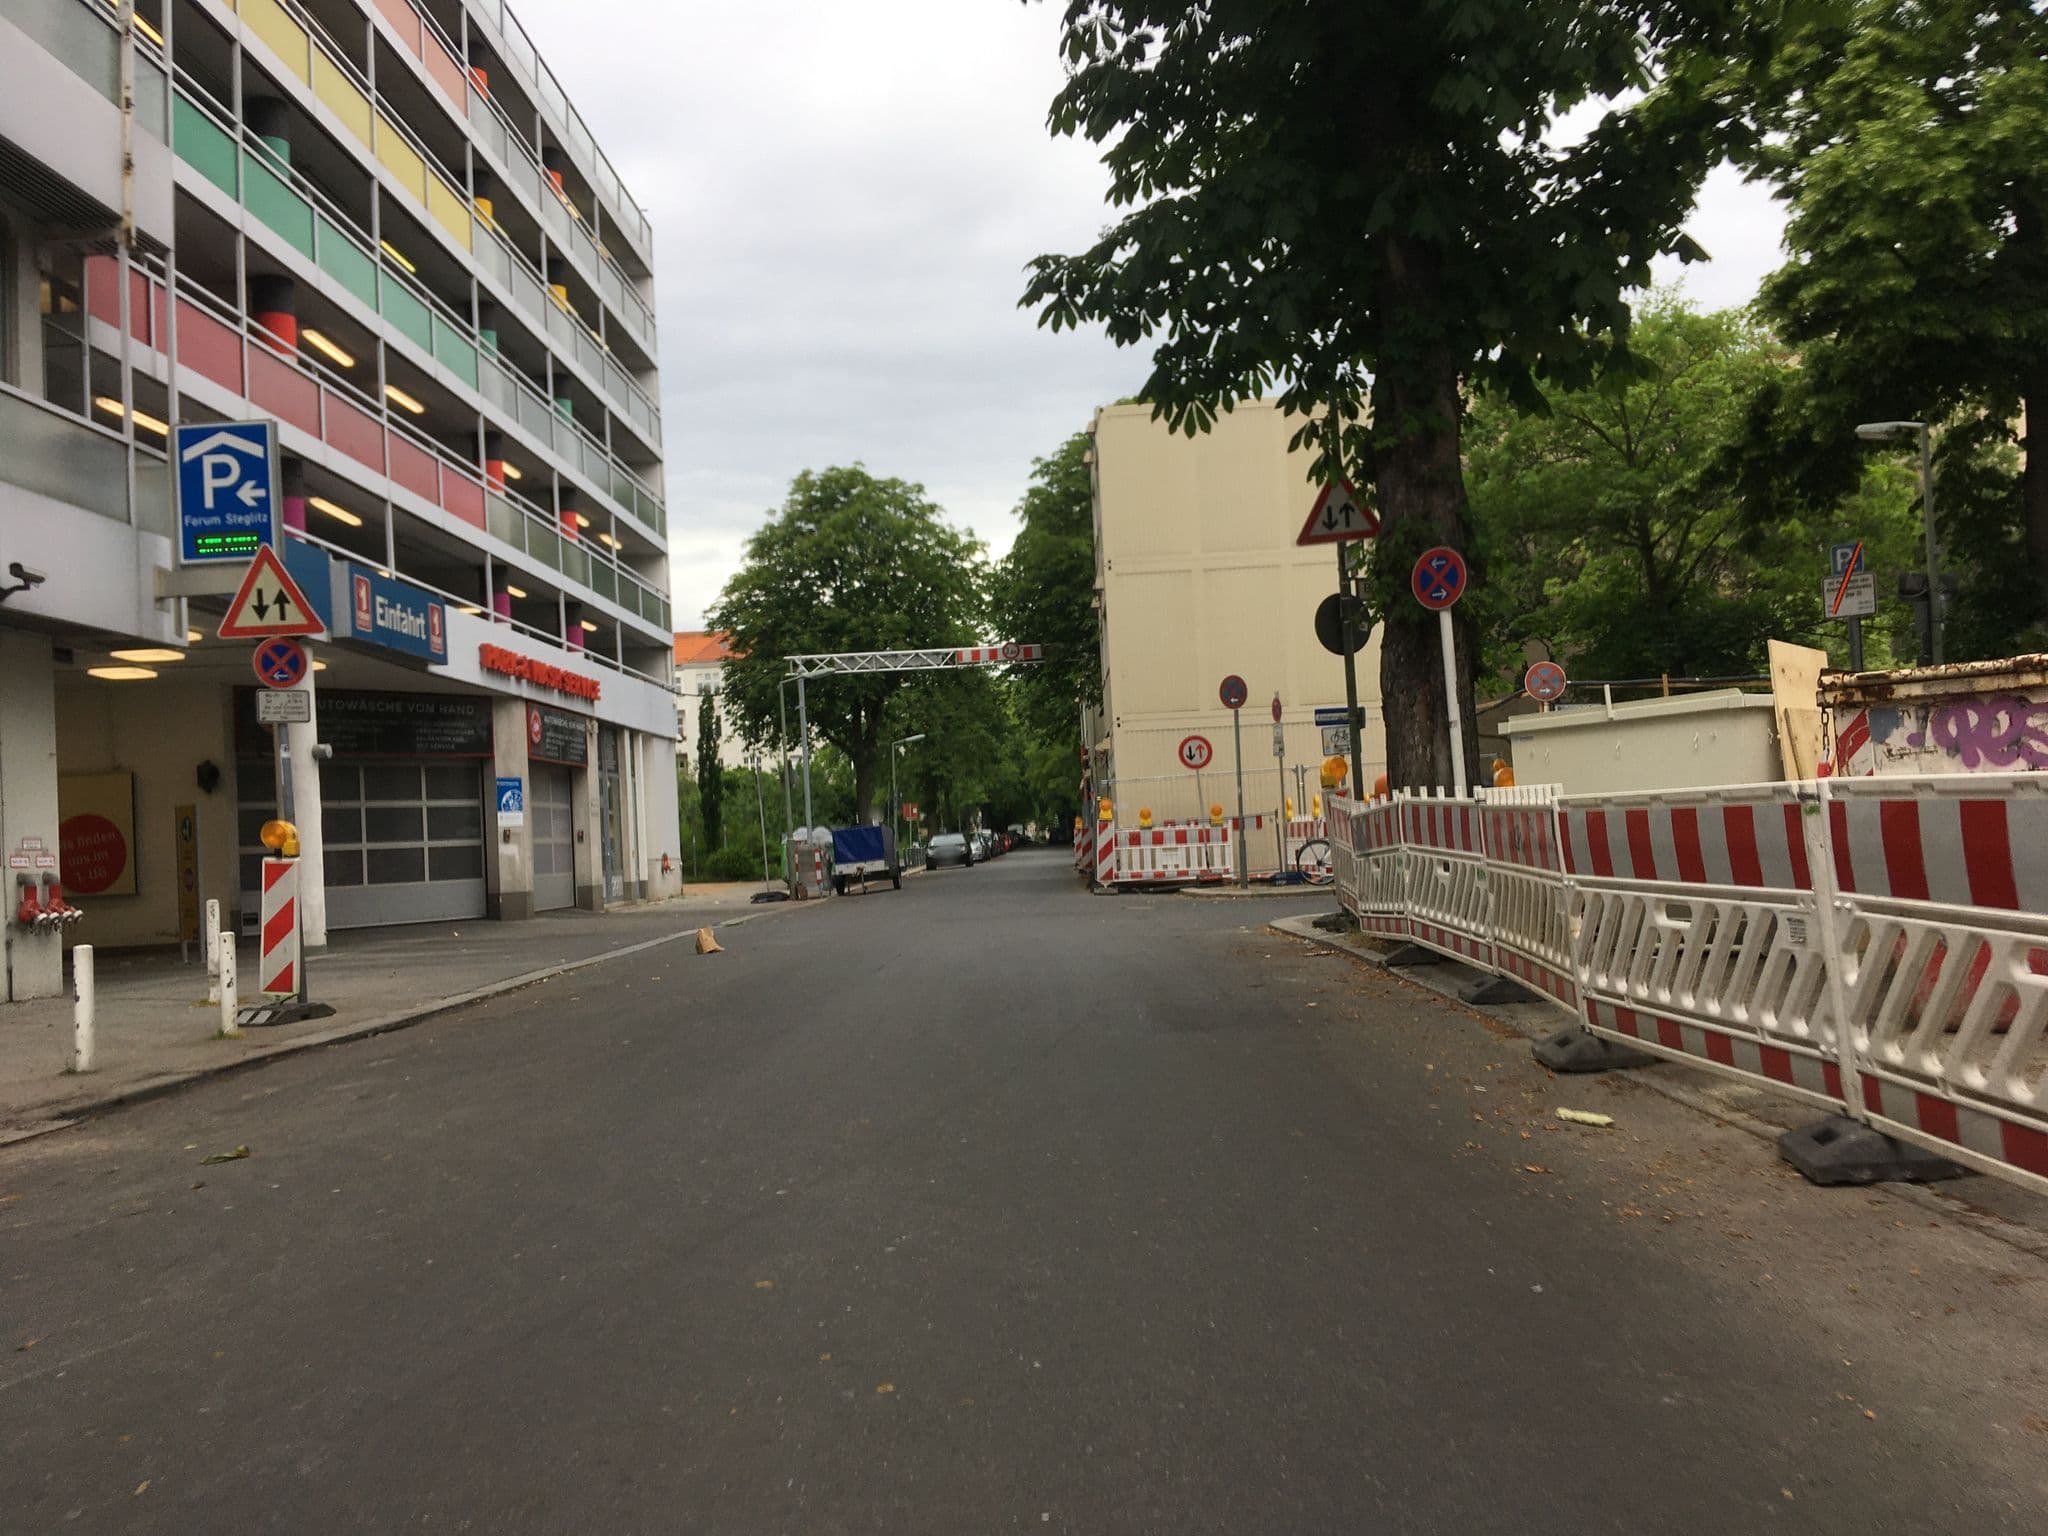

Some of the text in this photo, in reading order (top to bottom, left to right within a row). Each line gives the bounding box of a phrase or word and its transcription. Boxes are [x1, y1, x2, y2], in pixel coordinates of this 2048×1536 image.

[202, 454, 241, 509] P
[184, 512, 268, 527] Forum Steglitz
[375, 594, 427, 640] Einfahrt
[318, 699, 403, 713] UTOWÄSCHE
